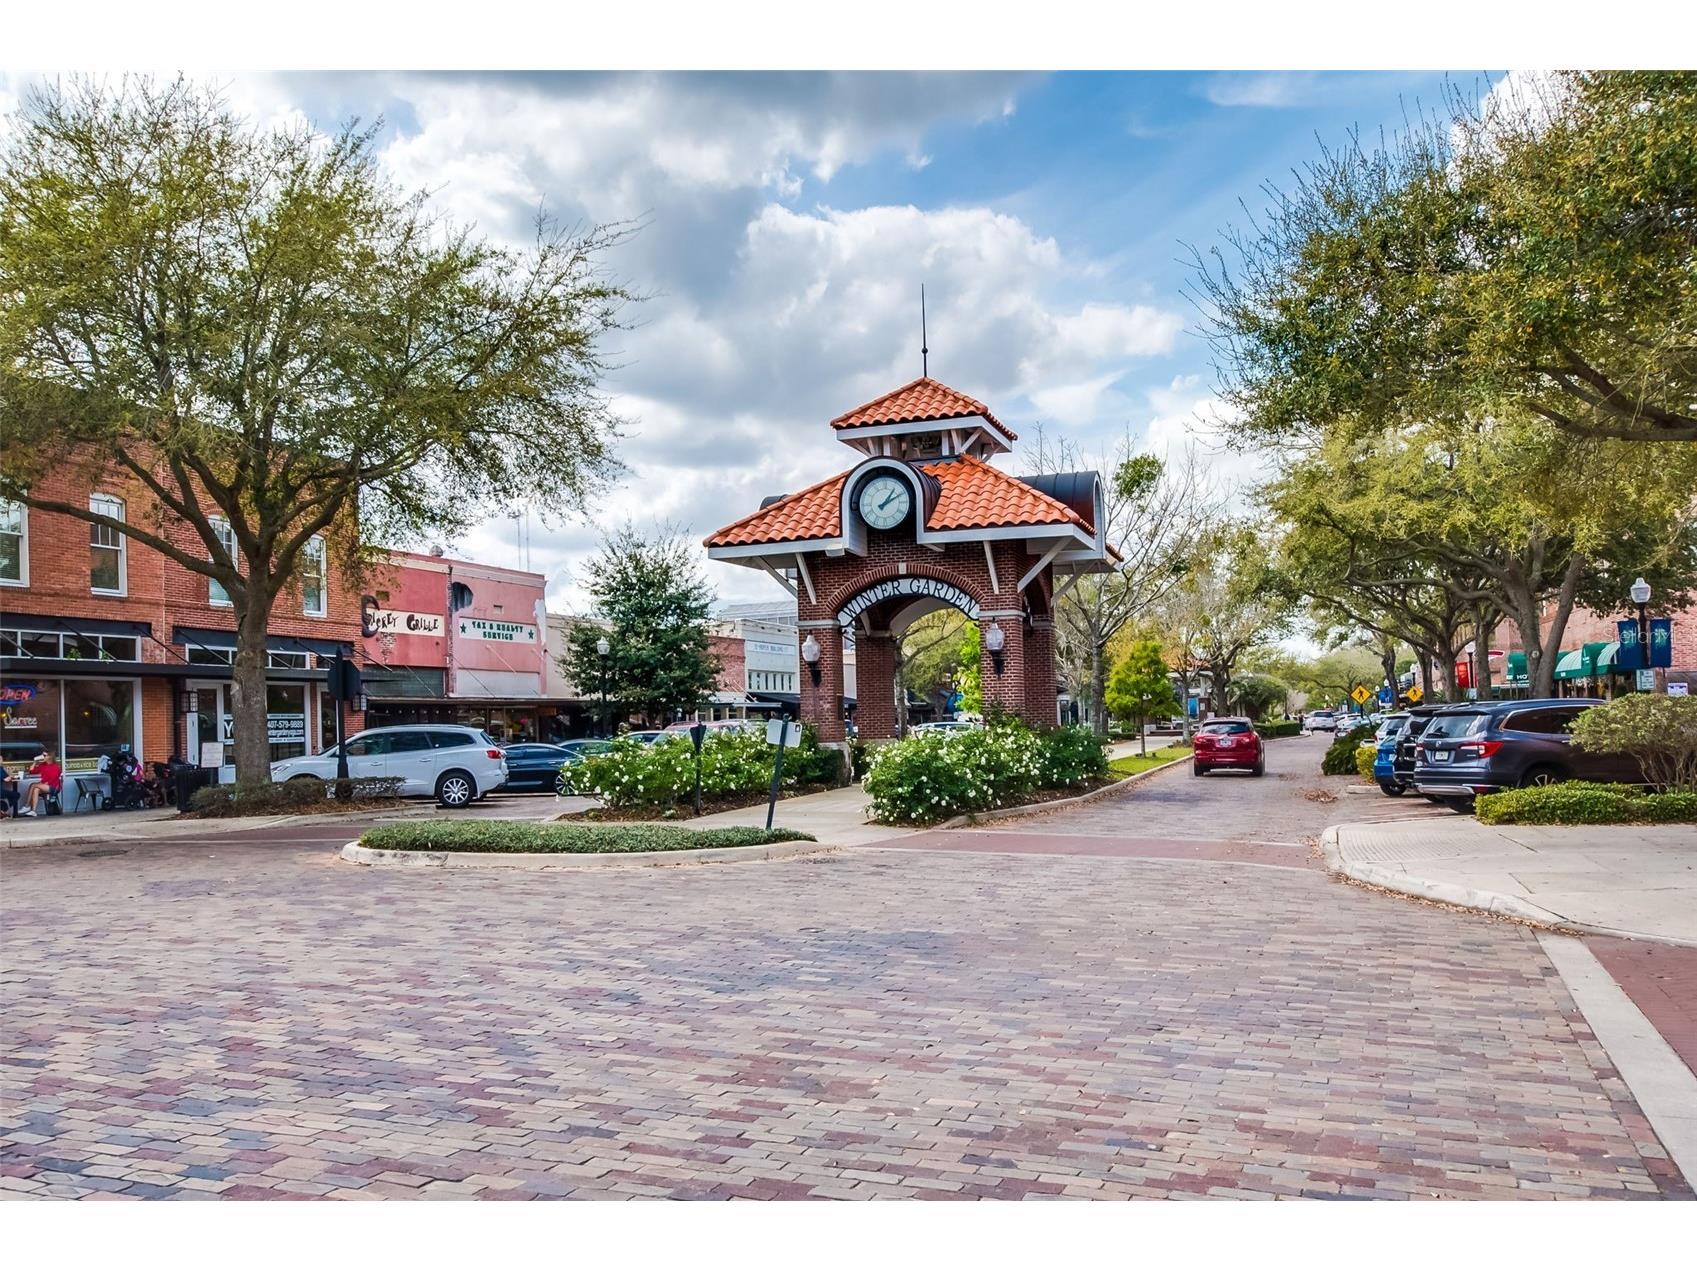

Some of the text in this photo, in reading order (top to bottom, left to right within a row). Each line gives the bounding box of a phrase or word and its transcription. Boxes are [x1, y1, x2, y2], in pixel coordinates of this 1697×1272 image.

[842, 577, 976, 619] WINTER GARDEN
[406, 613, 439, 631] GRILLE
[472, 621, 486, 629] TAX
[496, 624, 523, 632] REALTY
[483, 631, 513, 640] SERVICE
[0, 688, 31, 700] OPEN
